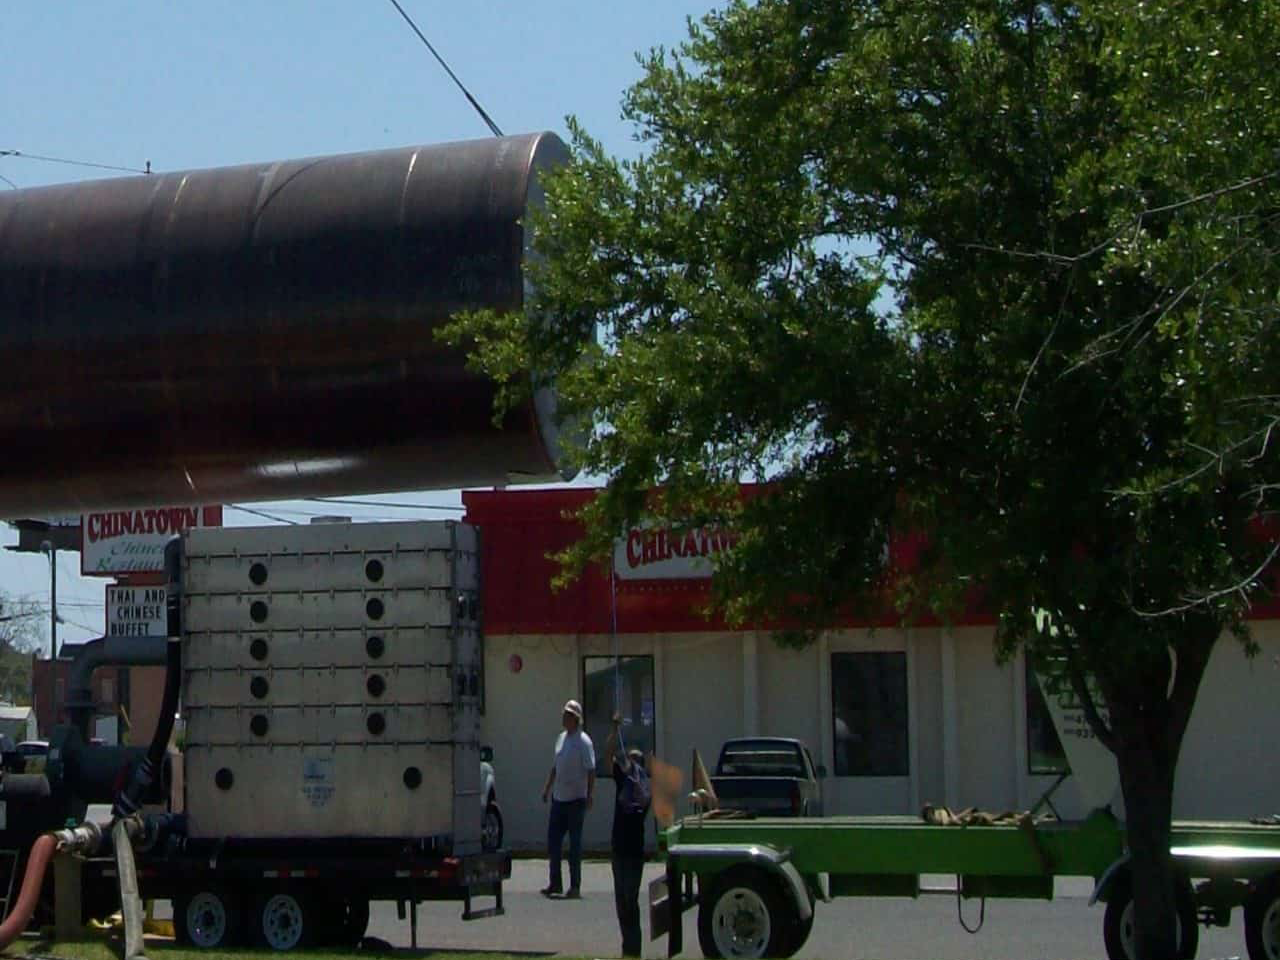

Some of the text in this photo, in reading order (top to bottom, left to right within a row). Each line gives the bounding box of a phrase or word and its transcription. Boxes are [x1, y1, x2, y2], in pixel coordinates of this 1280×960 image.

[87, 507, 199, 543] CHINATOWN
[111, 540, 165, 556] Chine
[110, 589, 166, 604] THAI AND
[117, 605, 161, 620] CHINESE
[111, 621, 150, 636] BUFFET
